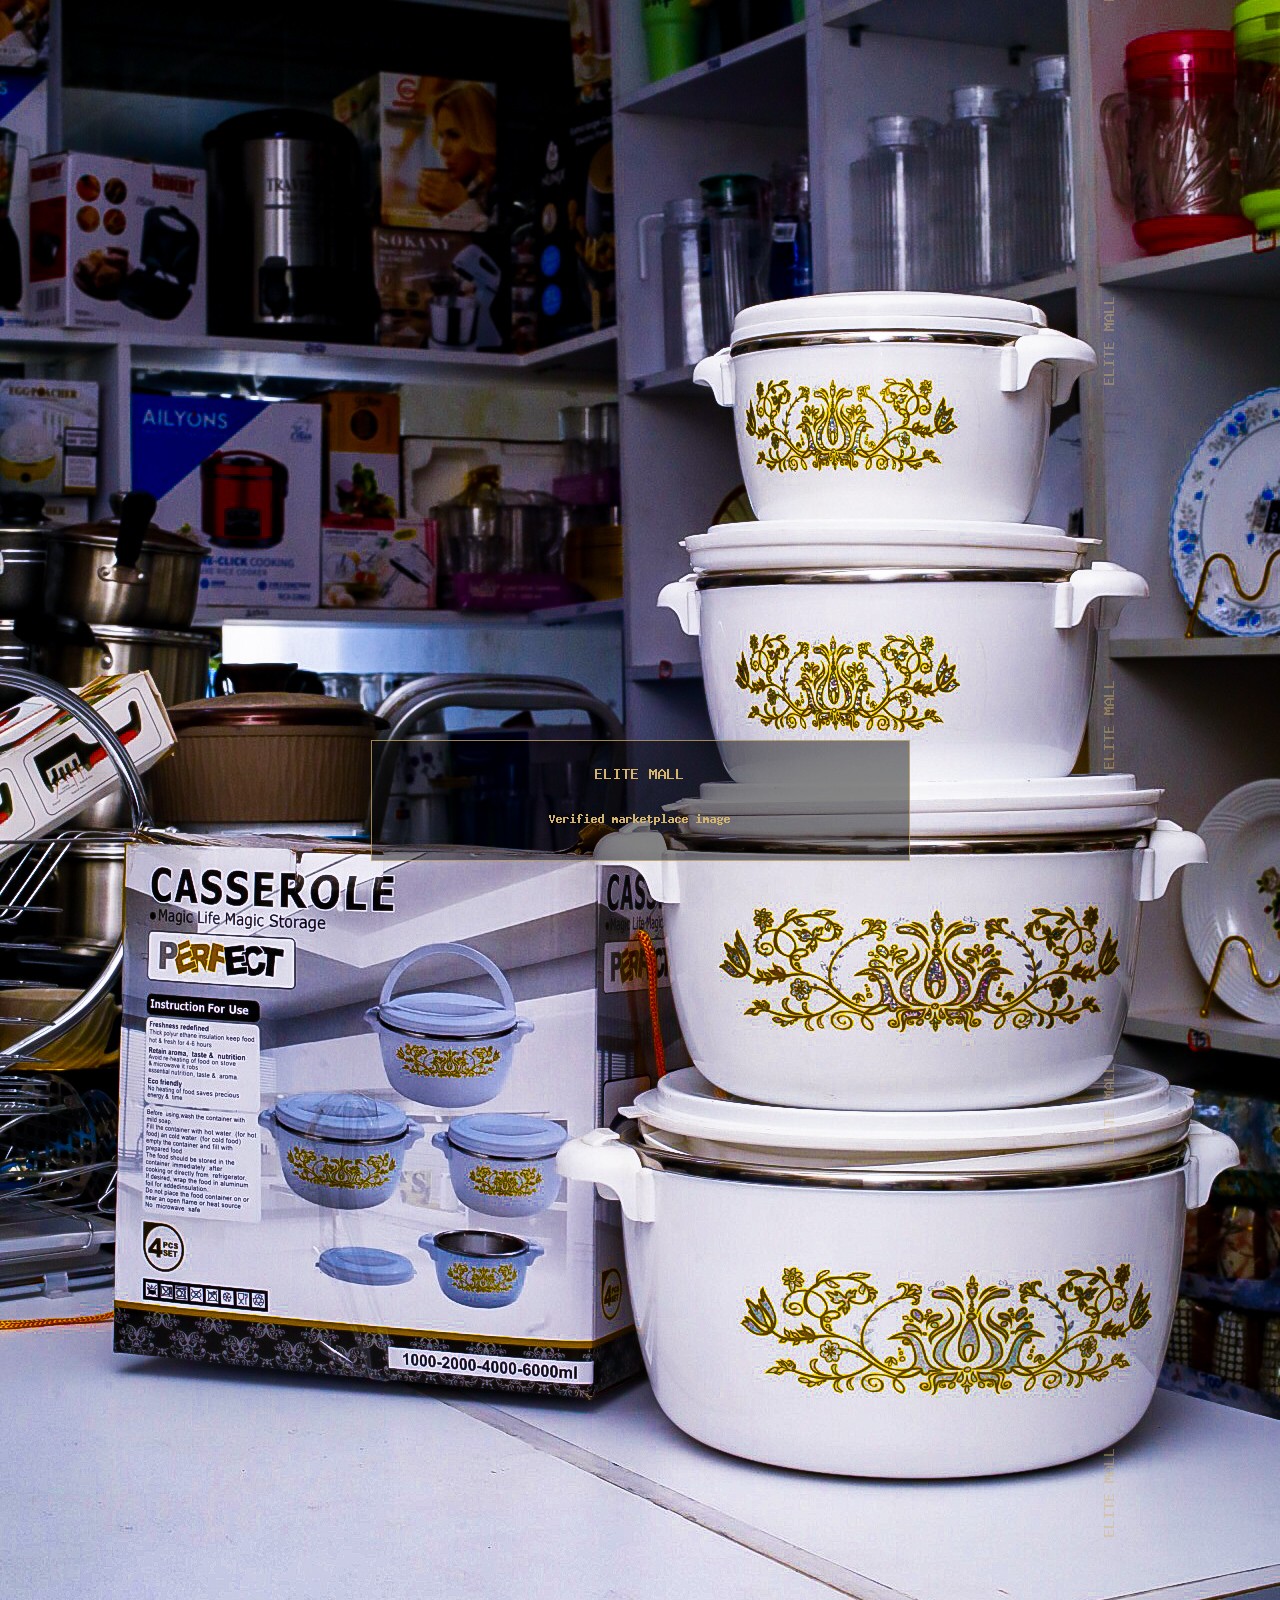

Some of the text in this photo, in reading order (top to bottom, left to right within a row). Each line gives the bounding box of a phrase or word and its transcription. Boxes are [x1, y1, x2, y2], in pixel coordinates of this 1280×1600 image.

[380, 235, 449, 250] SOKANY
[142, 408, 228, 429] AILYONS
[250, 557, 294, 568] COOKING
[151, 867, 394, 911] CASSEROLE
[158, 909, 326, 933] Magic Life Magic Storage
[159, 940, 284, 977] PERFECT
[150, 998, 249, 1015] Instruction For Use
[149, 1021, 178, 1029] Freshness
[199, 1032, 224, 1040] insulation
[226, 1034, 240, 1042] keep
[160, 1079, 182, 1088] friendly
[156, 1086, 174, 1094] heating
[146, 1146, 169, 1154] prepared
[172, 1162, 205, 1171] immediately
[174, 1169, 194, 1177] directly
[156, 1203, 185, 1211] microwave
[148, 1237, 179, 1258] 4 PCS
[163, 1249, 178, 1258] SET
[403, 1352, 578, 1380] 1000-2000-4000-6000ml
